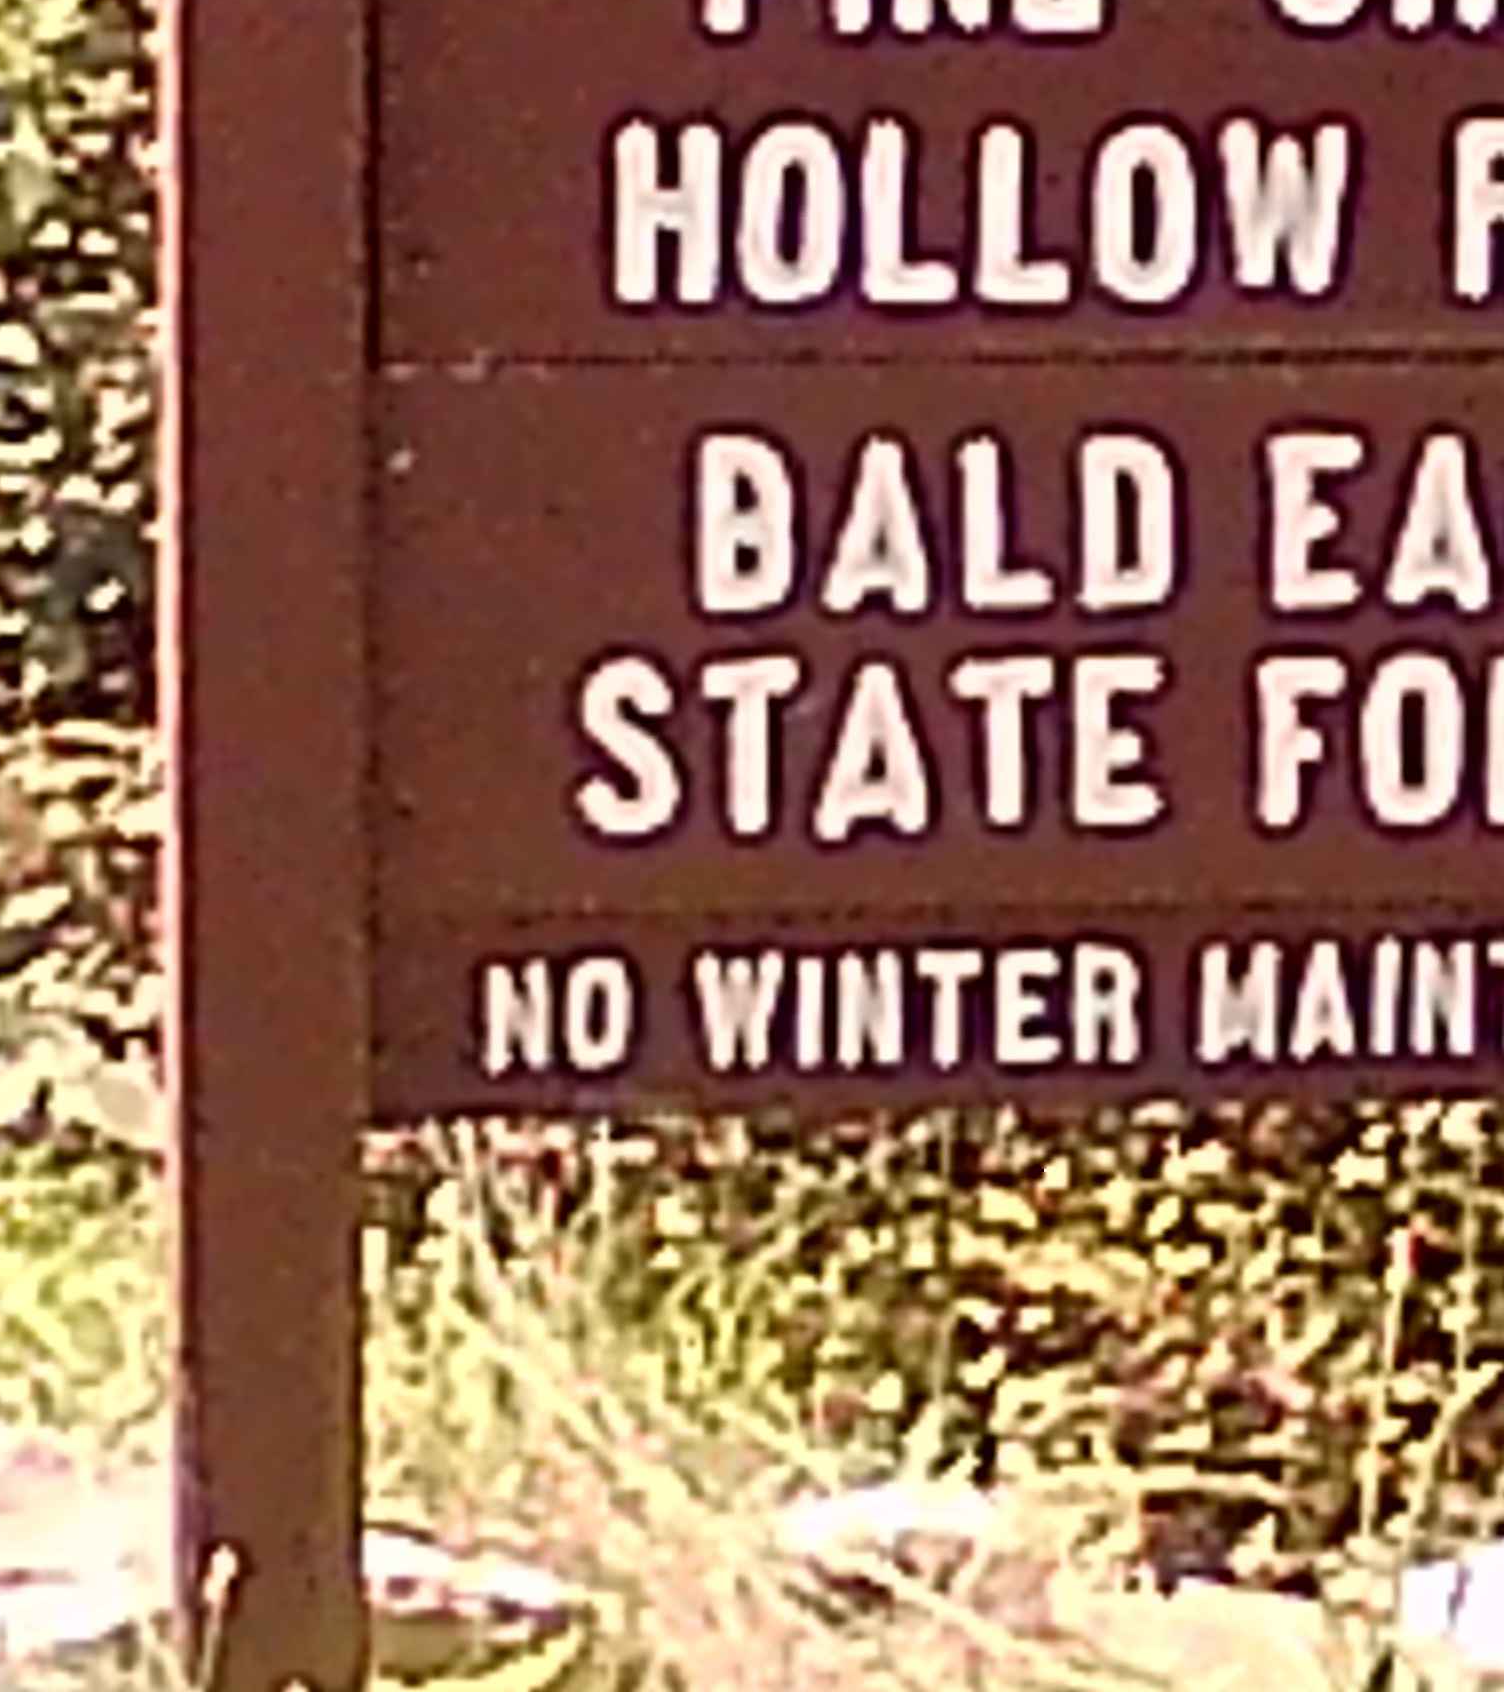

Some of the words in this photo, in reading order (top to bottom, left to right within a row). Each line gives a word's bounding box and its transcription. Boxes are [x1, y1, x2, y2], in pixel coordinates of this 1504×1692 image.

[615, 119, 1347, 303] HOLLOW
[700, 435, 1173, 612] BALD
[577, 656, 1163, 840] STATE
[485, 958, 631, 1074] NO
[695, 944, 1139, 1070] WINTER
